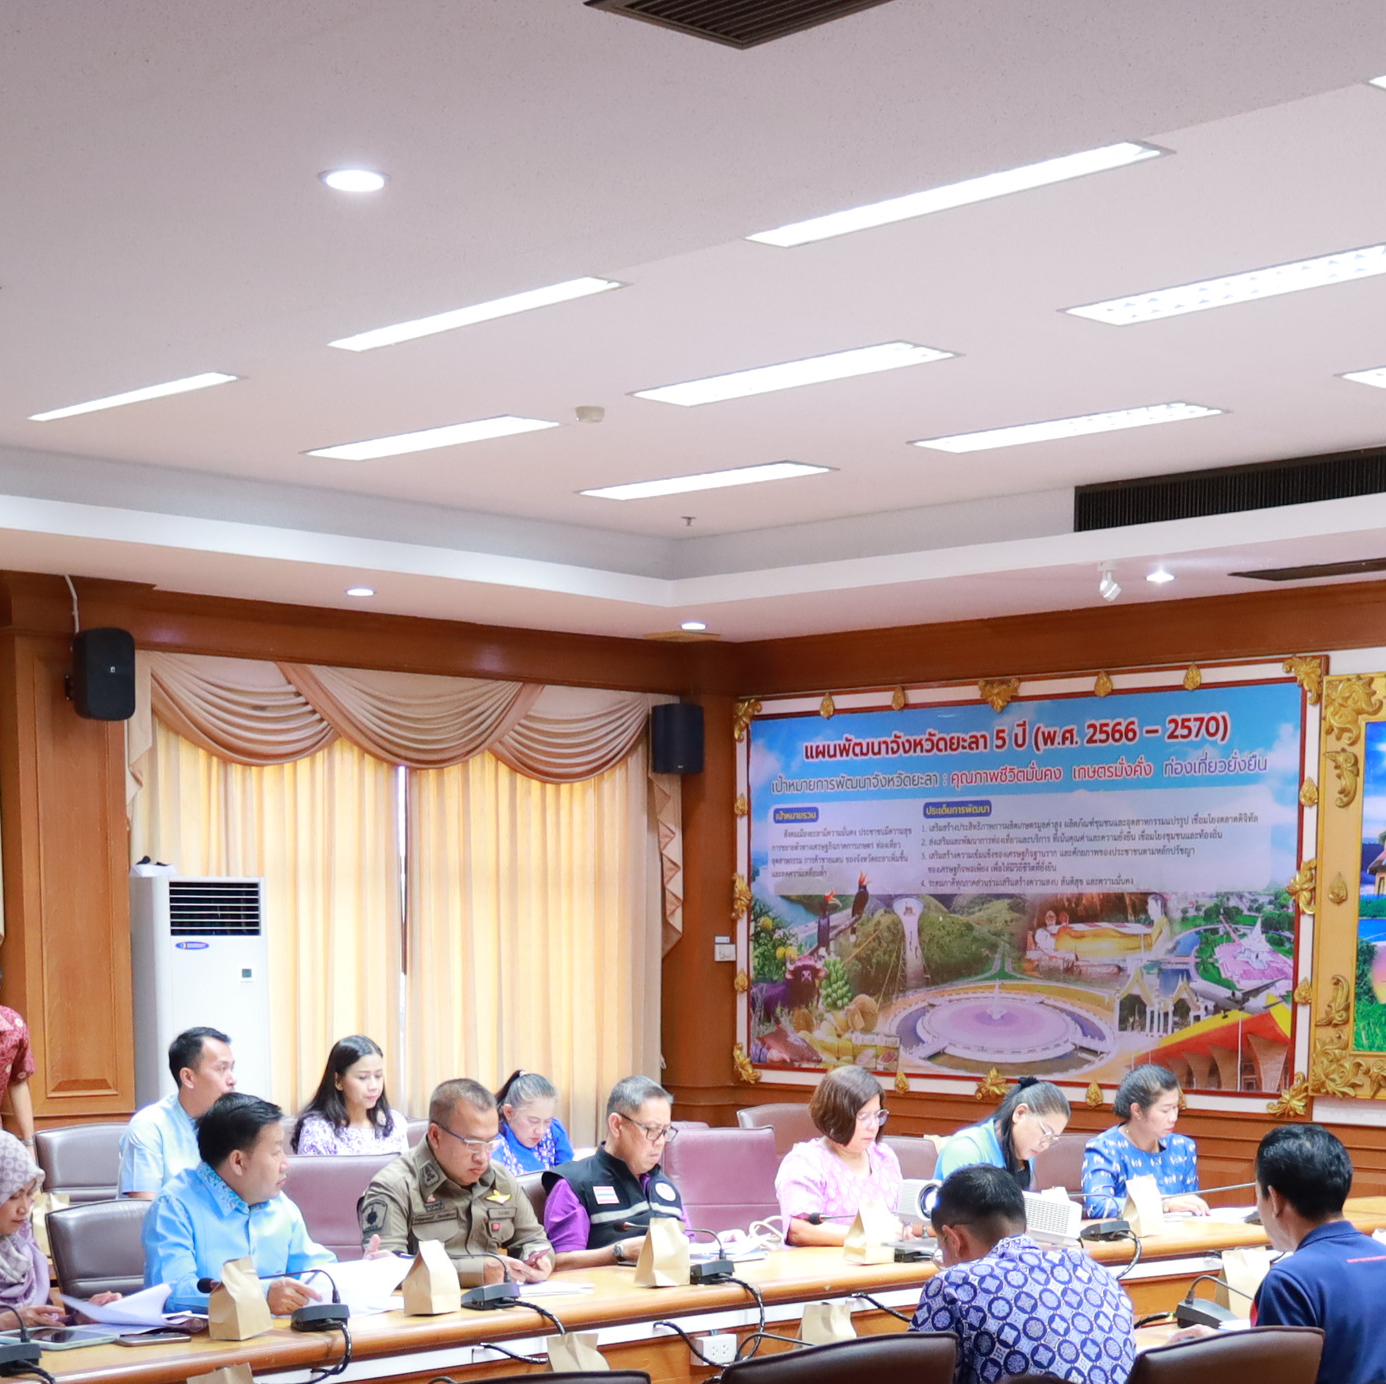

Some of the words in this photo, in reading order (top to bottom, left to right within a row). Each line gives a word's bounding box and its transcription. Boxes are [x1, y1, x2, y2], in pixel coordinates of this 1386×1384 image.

[804, 731, 988, 760] แผนพัฒนาจังหวัดยะลา
[995, 728, 1007, 749] 5
[1014, 720, 1027, 748] ปี
[1034, 725, 1079, 752] (พ.ศ.
[1086, 721, 1137, 744] 2566
[1166, 715, 1229, 742] 2570)
[772, 771, 938, 794] เป้าหมายการพัฒนาจังหวัดยะลา
[951, 762, 1062, 790] คุณภาพชีวิตมั่นคง
[1073, 756, 1153, 780] เกษตรมั่งคั่ง
[1164, 751, 1268, 777] ท่องเที่ยวยั่งยืน
[925, 803, 990, 815] ประเด็นการพัฒนา
